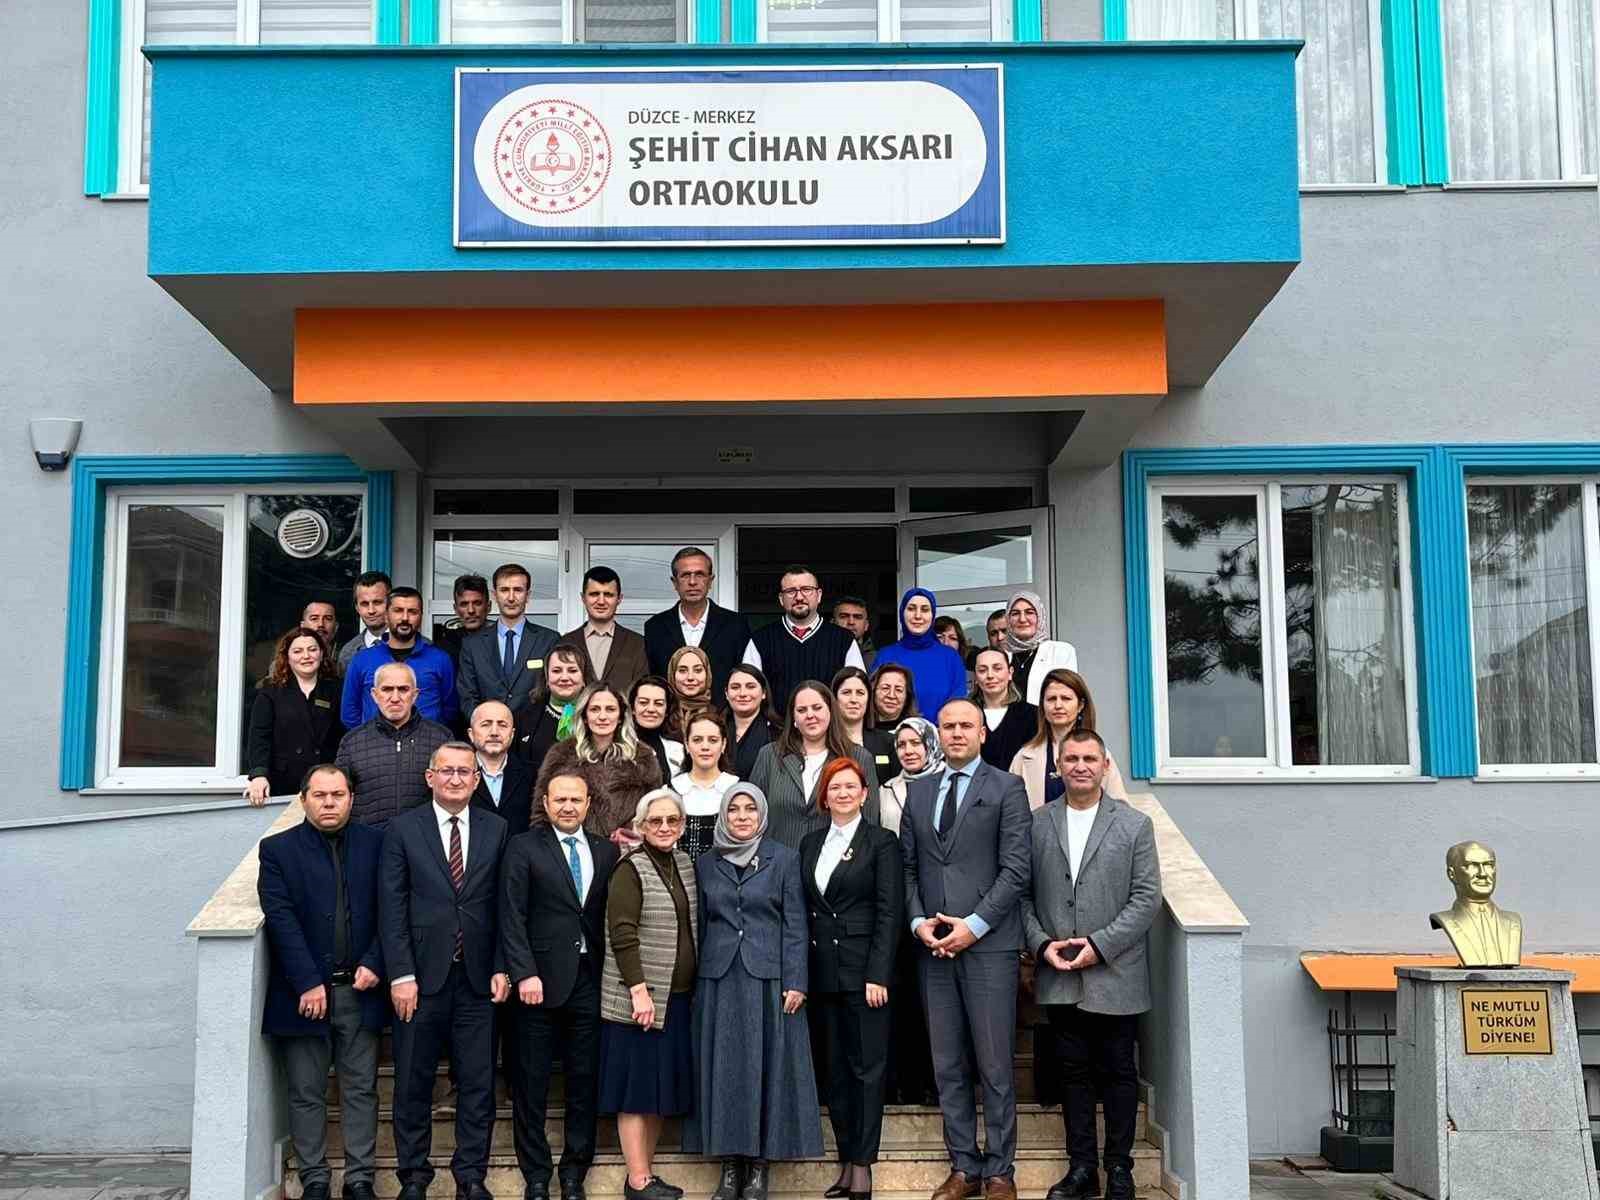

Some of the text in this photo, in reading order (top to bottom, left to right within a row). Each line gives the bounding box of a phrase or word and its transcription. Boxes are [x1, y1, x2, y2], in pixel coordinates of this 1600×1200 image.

[628, 108, 681, 124] DÜZCE
[693, 110, 756, 124] MERKEZ
[628, 130, 952, 169] ŞEHİT CİHAN AKSARI
[629, 179, 819, 206] ORTAOKULU
[1471, 1001, 1540, 1012] NE MUTLU
[1477, 1014, 1536, 1027] TÜRKÜM
[1481, 1029, 1535, 1043] DİYENE!
